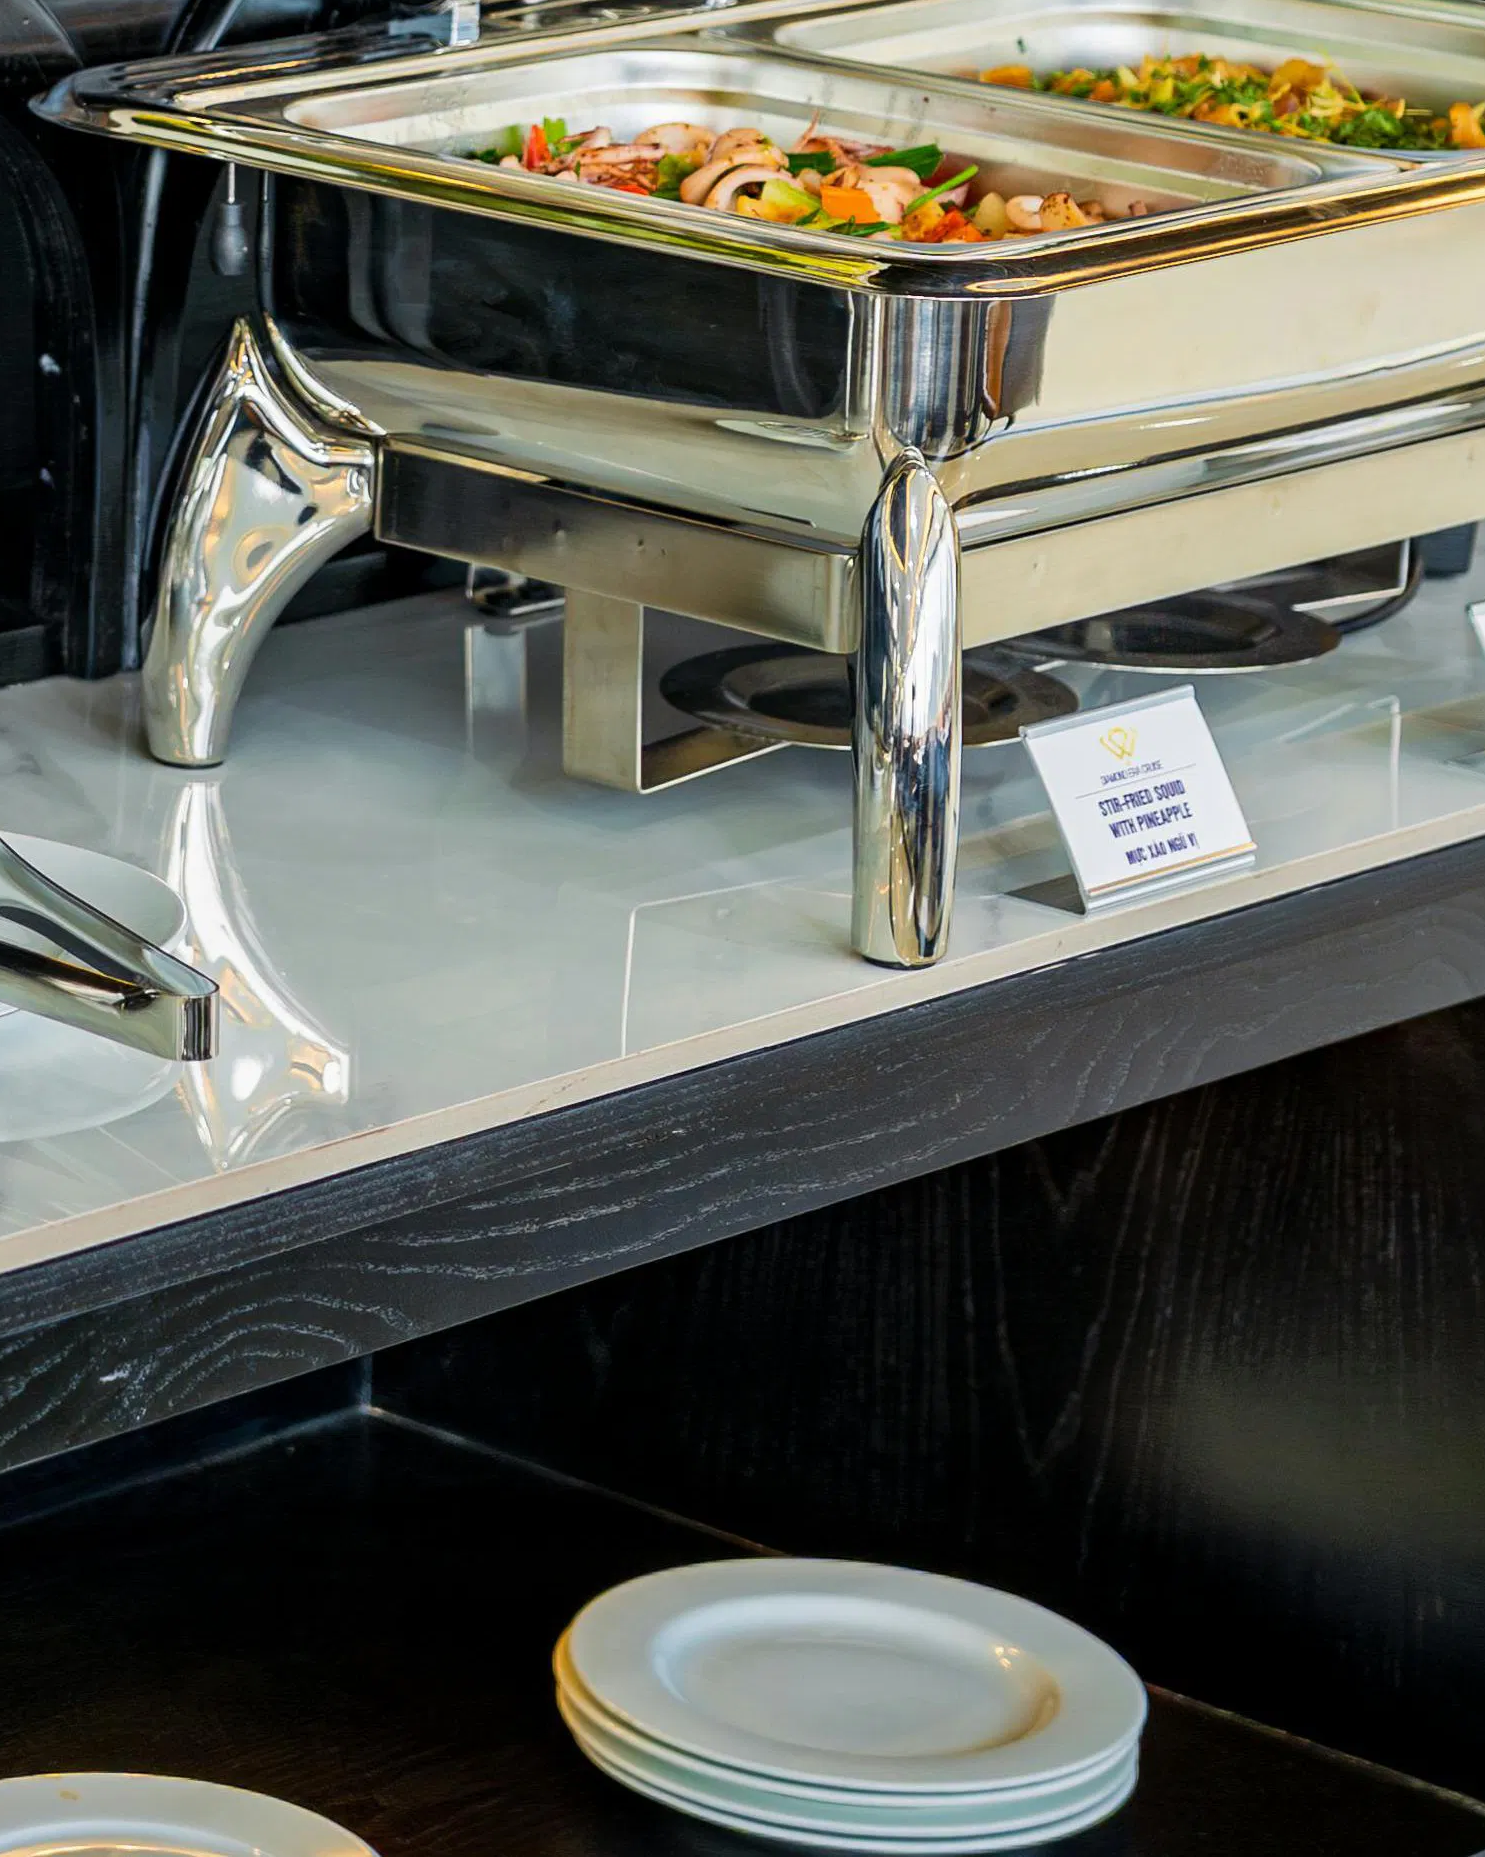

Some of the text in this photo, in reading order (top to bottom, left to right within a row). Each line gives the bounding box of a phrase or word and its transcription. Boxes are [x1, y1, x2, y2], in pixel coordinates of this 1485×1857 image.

[1098, 779, 1185, 816] STIR-FRIED SQUID
[1109, 802, 1193, 838] WITH PINEAPPLE
